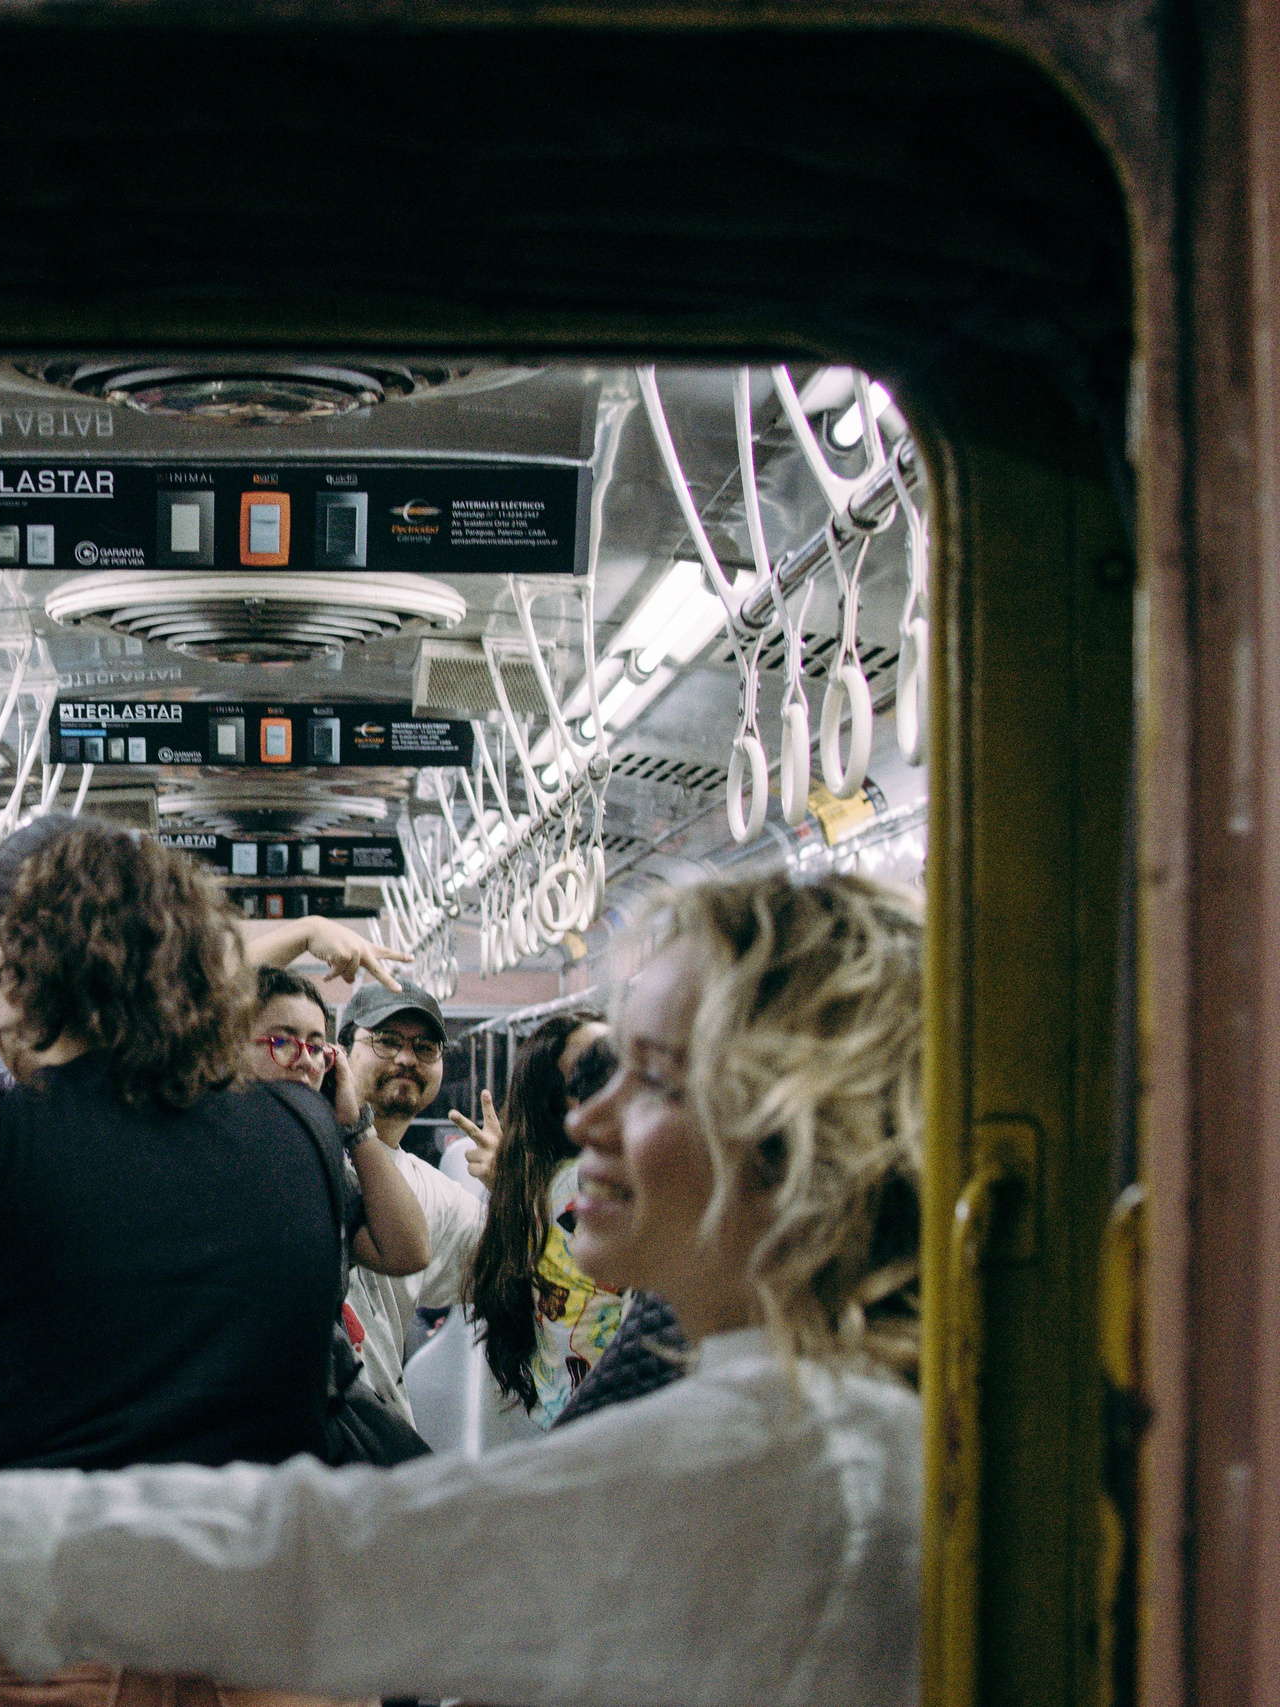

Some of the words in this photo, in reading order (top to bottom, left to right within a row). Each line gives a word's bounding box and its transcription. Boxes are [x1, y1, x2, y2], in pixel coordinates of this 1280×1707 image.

[157, 472, 216, 485] INIMAL
[452, 500, 499, 510] MATERIALES
[74, 703, 182, 720] TECLASTAR
